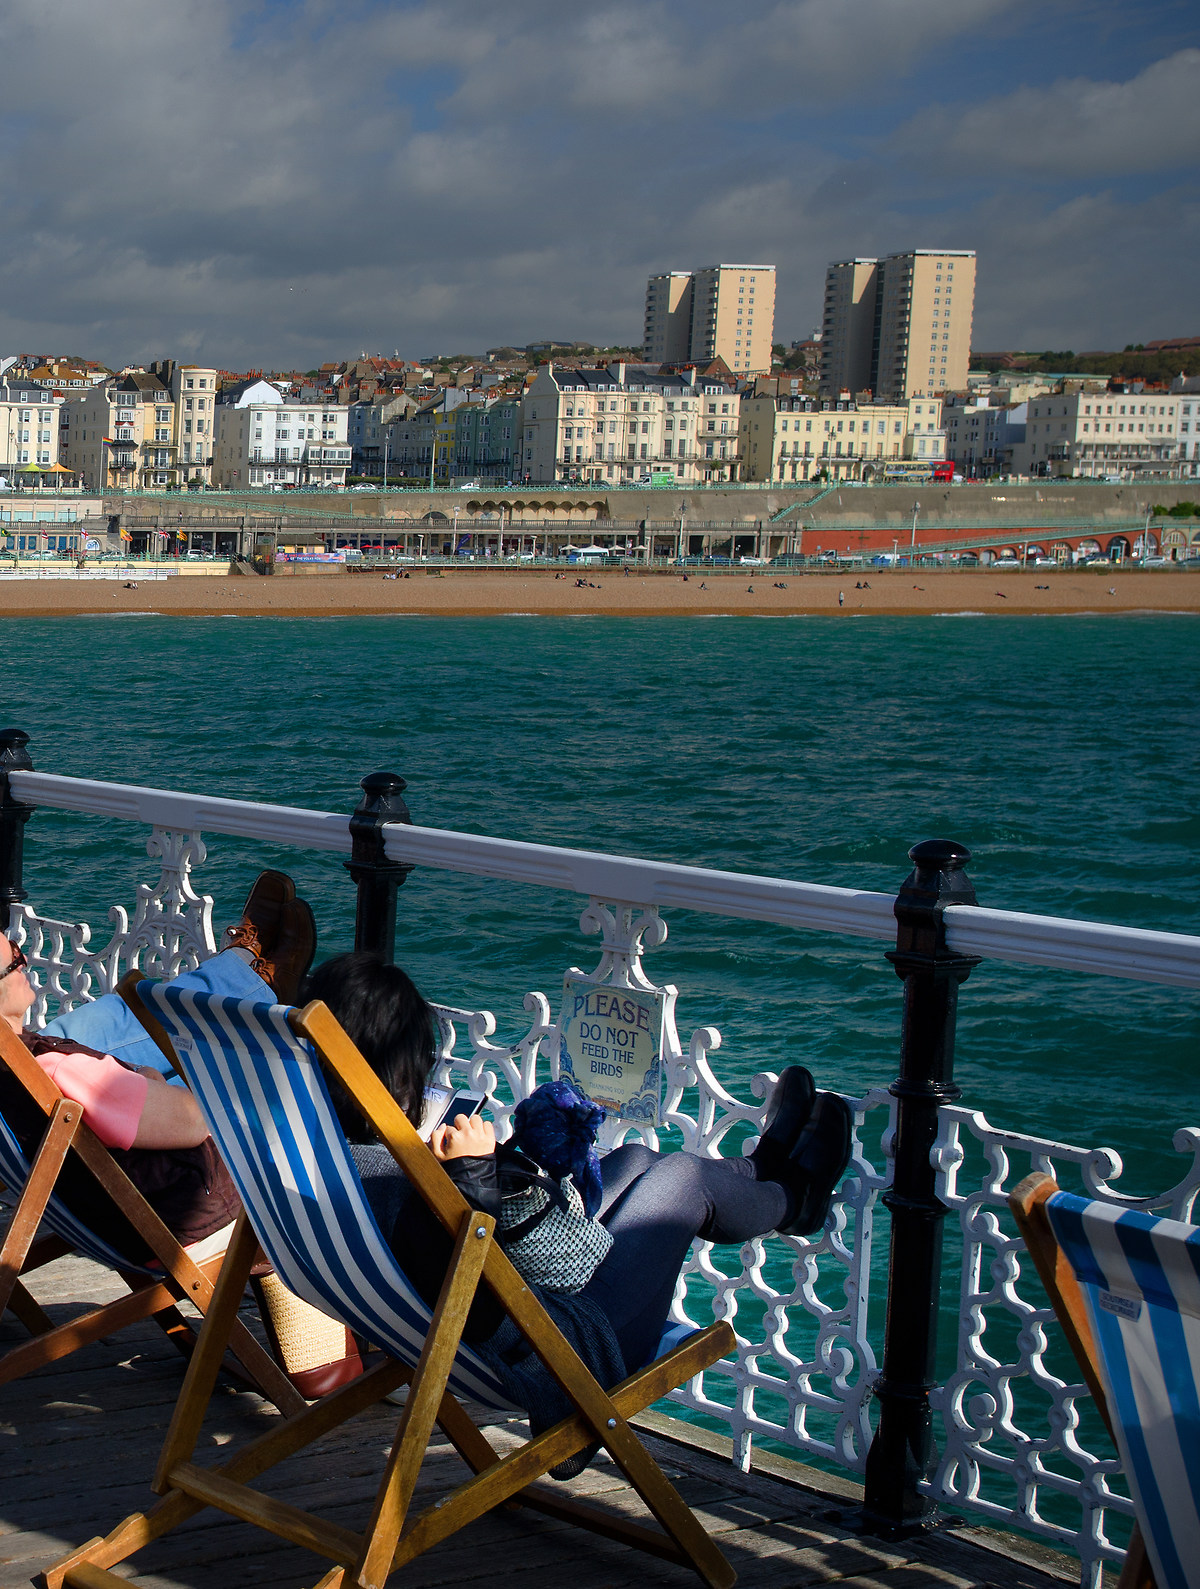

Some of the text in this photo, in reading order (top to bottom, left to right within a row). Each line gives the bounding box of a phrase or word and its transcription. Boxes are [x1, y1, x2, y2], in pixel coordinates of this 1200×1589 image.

[573, 994, 650, 1032] PLEASE
[580, 1022, 638, 1049] DO NOT
[581, 1042, 635, 1065] FEED THE
[590, 1061, 623, 1079] BIRDS
[613, 1087, 625, 1095] YOU
